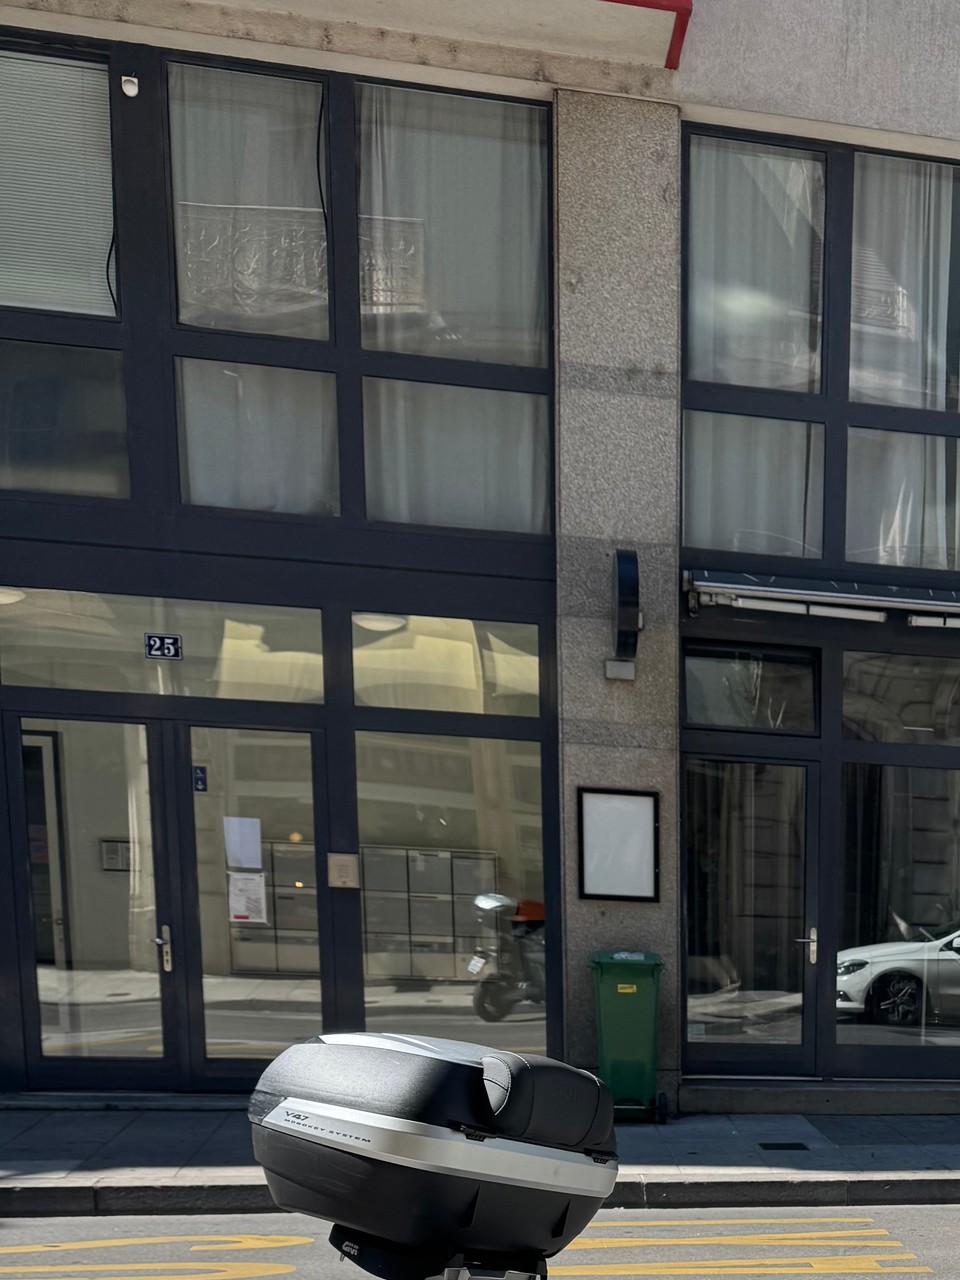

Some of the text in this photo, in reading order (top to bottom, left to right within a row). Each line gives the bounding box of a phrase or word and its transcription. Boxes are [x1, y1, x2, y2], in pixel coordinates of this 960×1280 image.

[150, 637, 176, 656] 25
[285, 1110, 310, 1121] V47
[328, 1130, 371, 1143] SYSTEM
